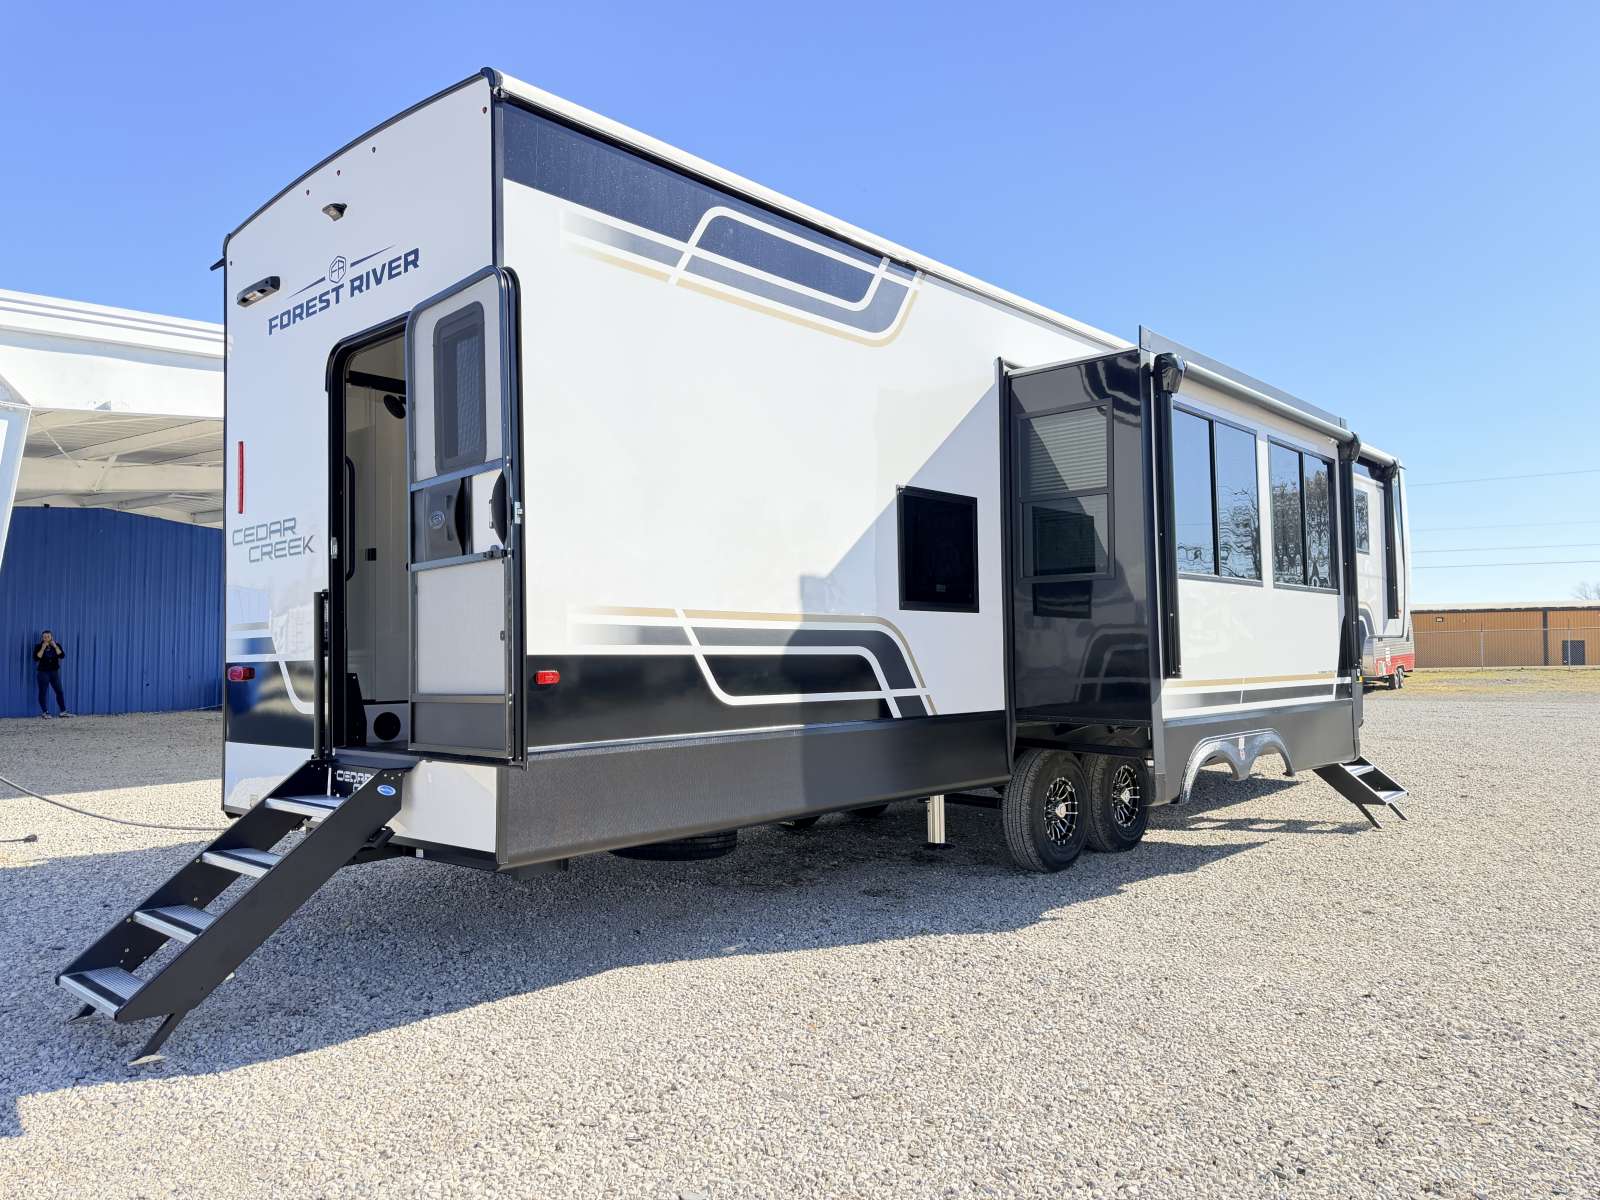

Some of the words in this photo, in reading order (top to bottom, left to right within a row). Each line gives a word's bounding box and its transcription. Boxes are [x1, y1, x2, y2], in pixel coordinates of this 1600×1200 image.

[268, 283, 344, 336] FOREST
[349, 247, 419, 298] RIVER
[232, 517, 296, 546] CEDAR
[249, 535, 315, 563] CREEK
